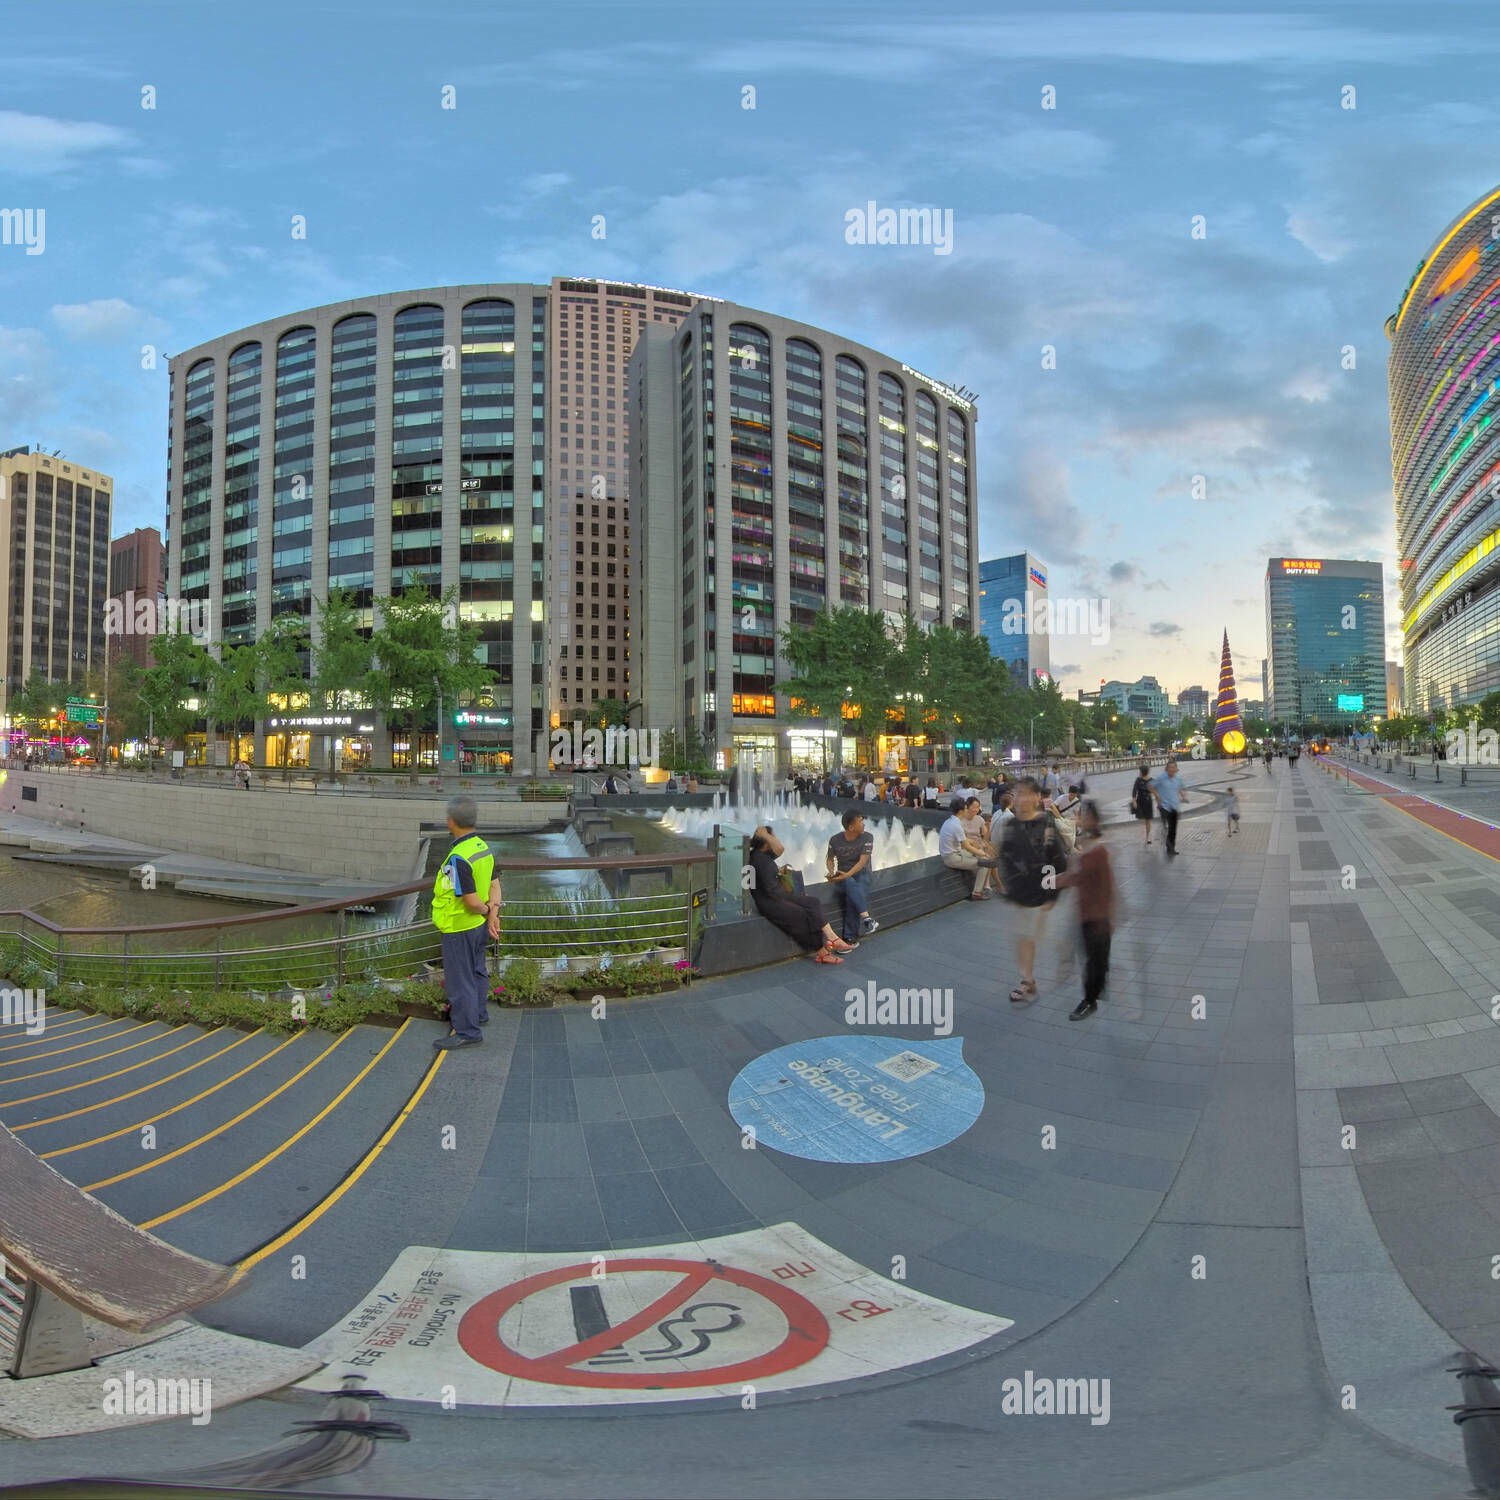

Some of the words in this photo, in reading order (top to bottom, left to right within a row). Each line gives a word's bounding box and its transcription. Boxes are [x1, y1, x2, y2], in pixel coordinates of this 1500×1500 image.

[825, 1056, 873, 1088] Zone
[787, 1059, 909, 1140] Language
[870, 1083, 921, 1113] Free
[438, 1294, 462, 1306] No
[408, 1307, 457, 1347] Smoking
